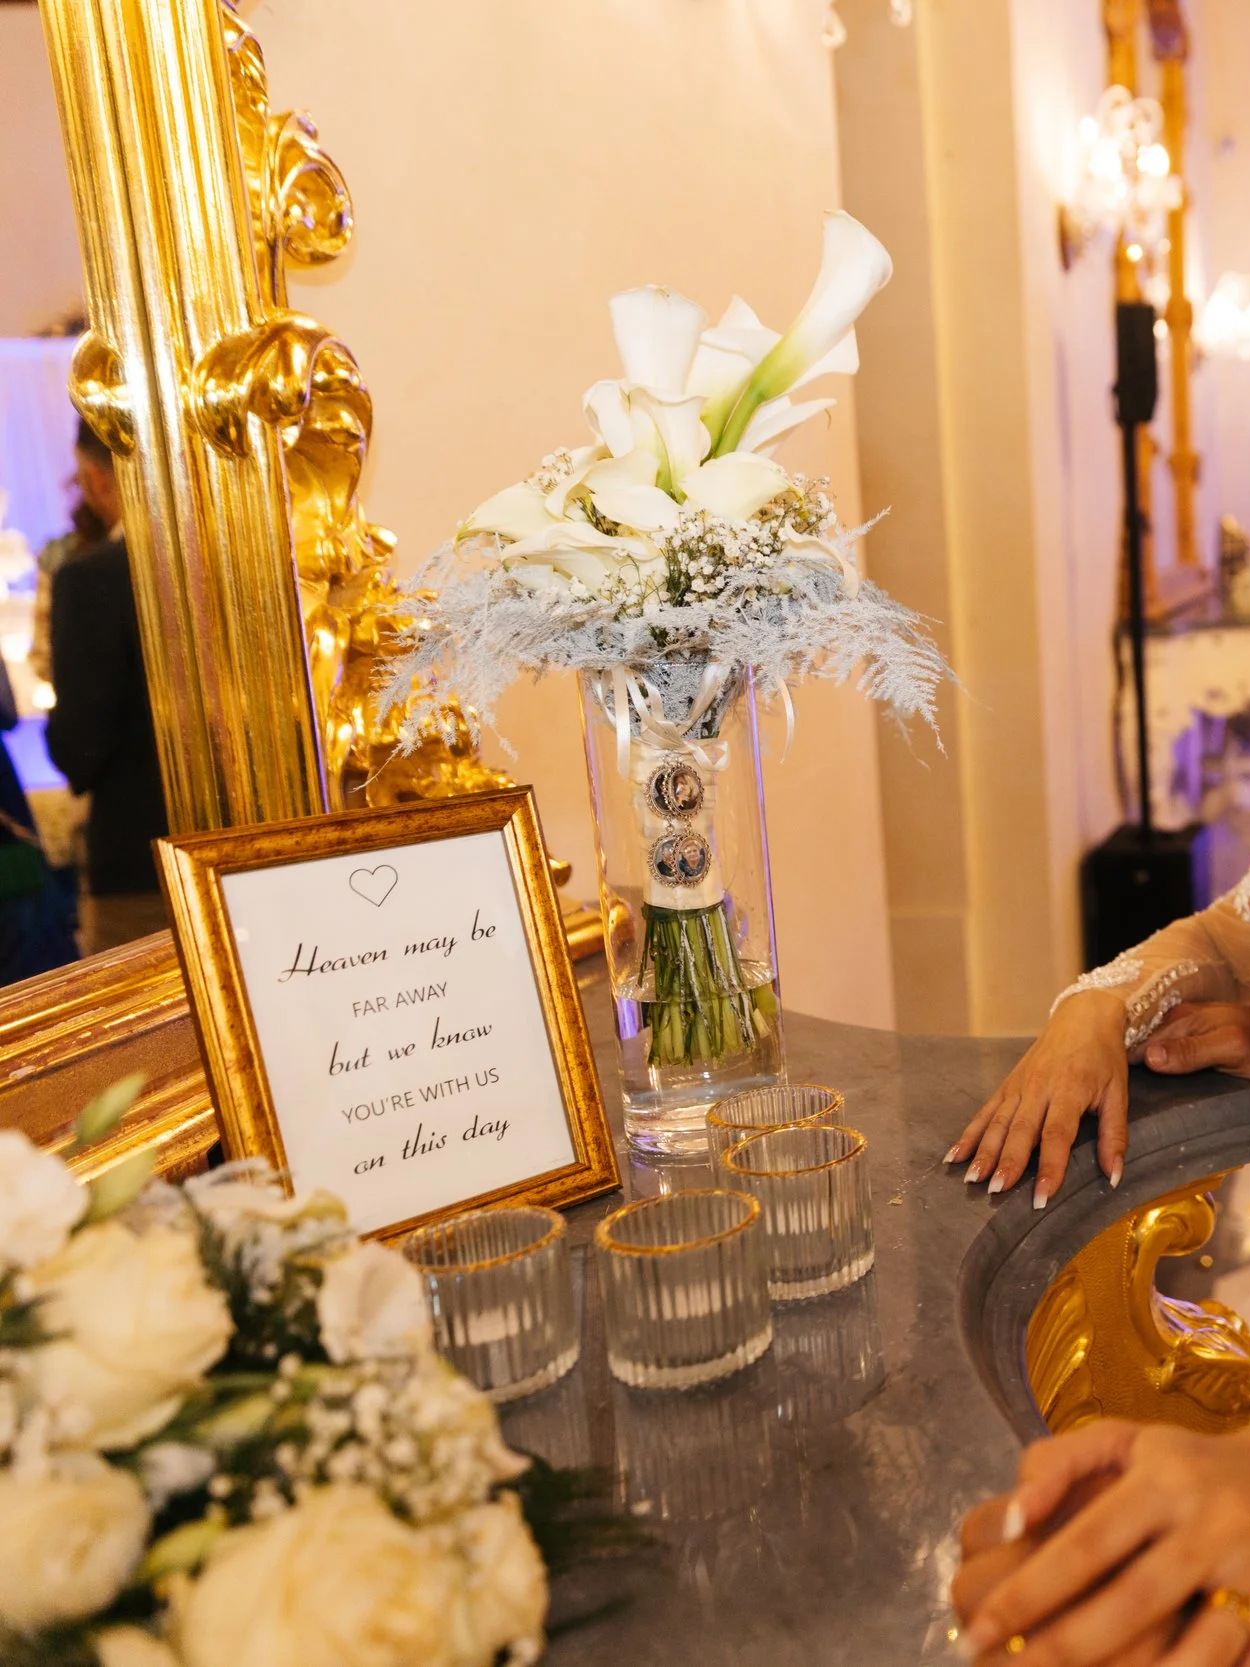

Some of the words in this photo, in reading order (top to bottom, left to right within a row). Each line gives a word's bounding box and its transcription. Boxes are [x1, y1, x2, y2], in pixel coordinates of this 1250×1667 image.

[276, 942, 389, 984] Heaven
[403, 936, 459, 959] may
[470, 908, 497, 942] be
[351, 996, 390, 1019] FAR
[395, 980, 448, 1009] AWAY
[328, 1040, 371, 1077] but
[387, 1042, 416, 1061] we
[430, 1016, 493, 1051] know
[341, 1090, 416, 1125] YOU'RE
[418, 1075, 471, 1103] WITH
[474, 1067, 500, 1087] US
[353, 1154, 387, 1175] on
[401, 1122, 448, 1161] this
[461, 1113, 512, 1142] day
